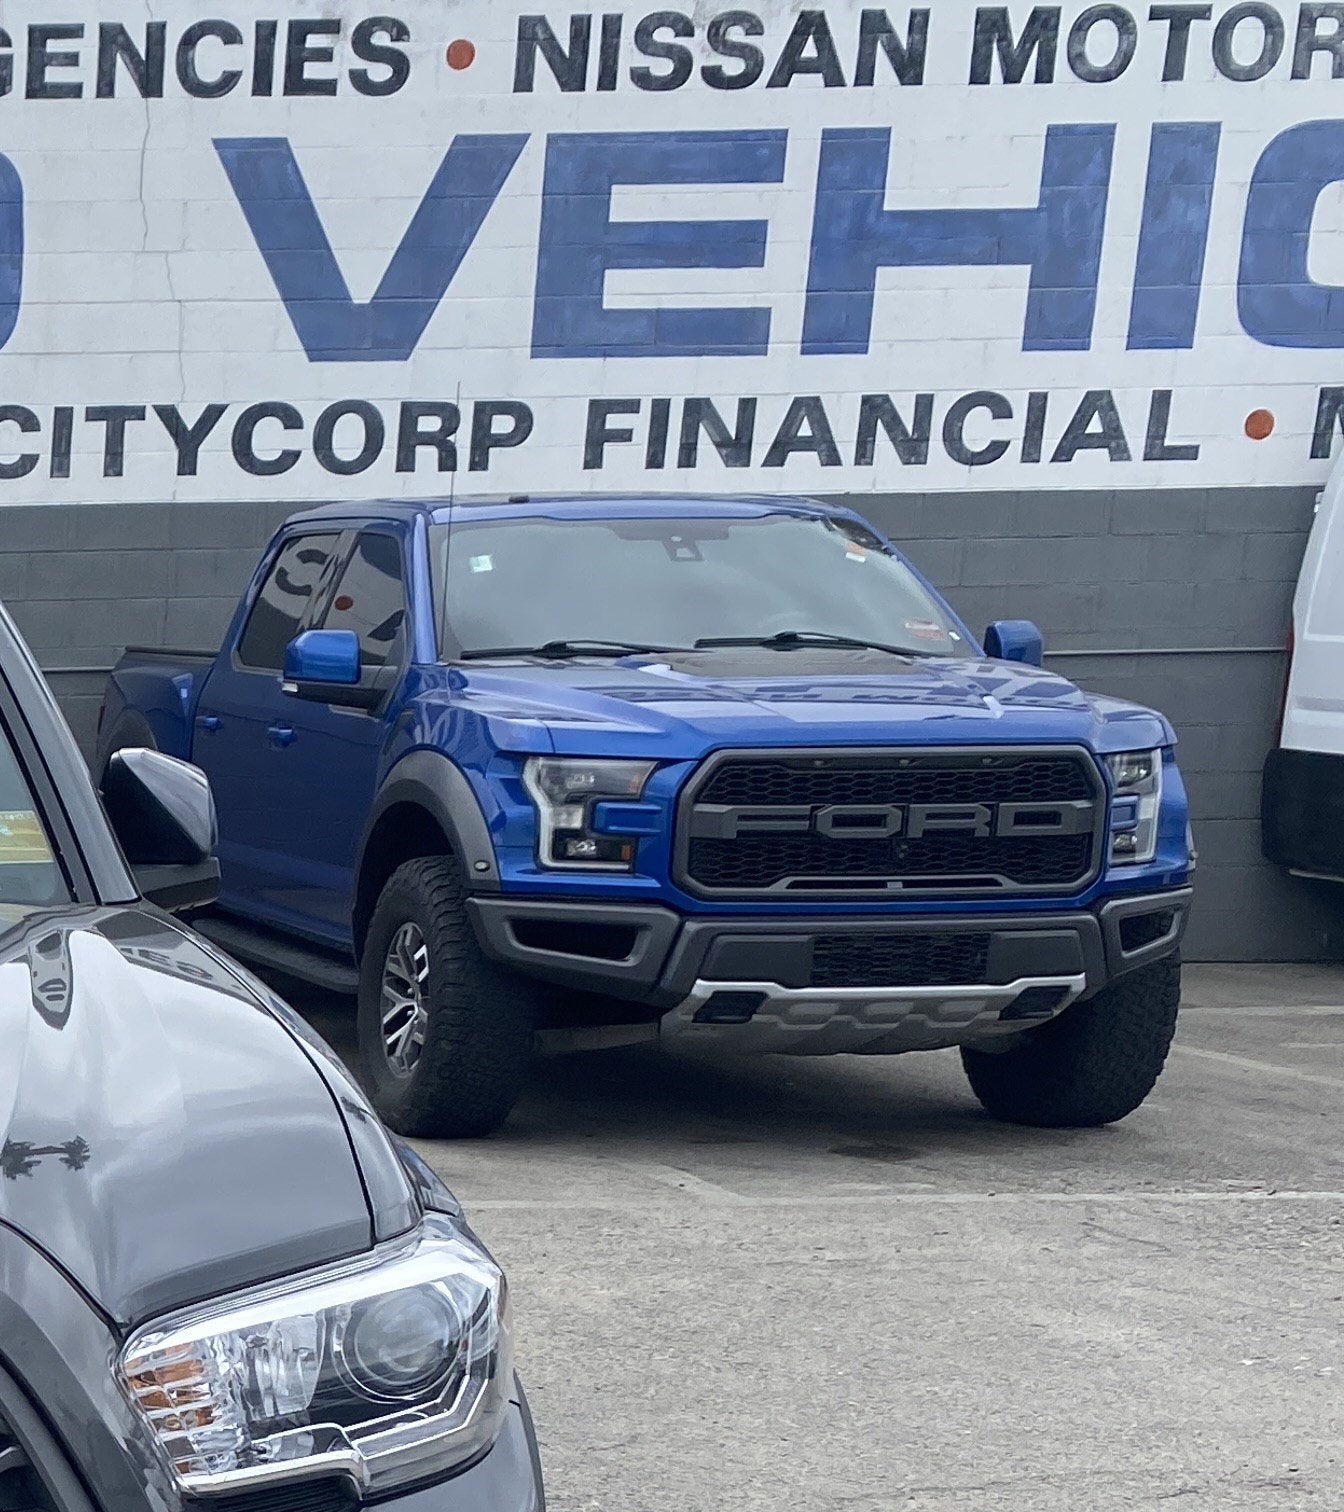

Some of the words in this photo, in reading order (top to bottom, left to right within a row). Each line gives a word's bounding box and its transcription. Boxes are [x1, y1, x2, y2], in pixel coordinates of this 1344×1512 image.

[513, 9, 930, 92] NISSAN
[968, 2, 1344, 85] MOTOR
[583, 390, 1200, 470] FINANCIAL
[700, 803, 1085, 838] FORD
